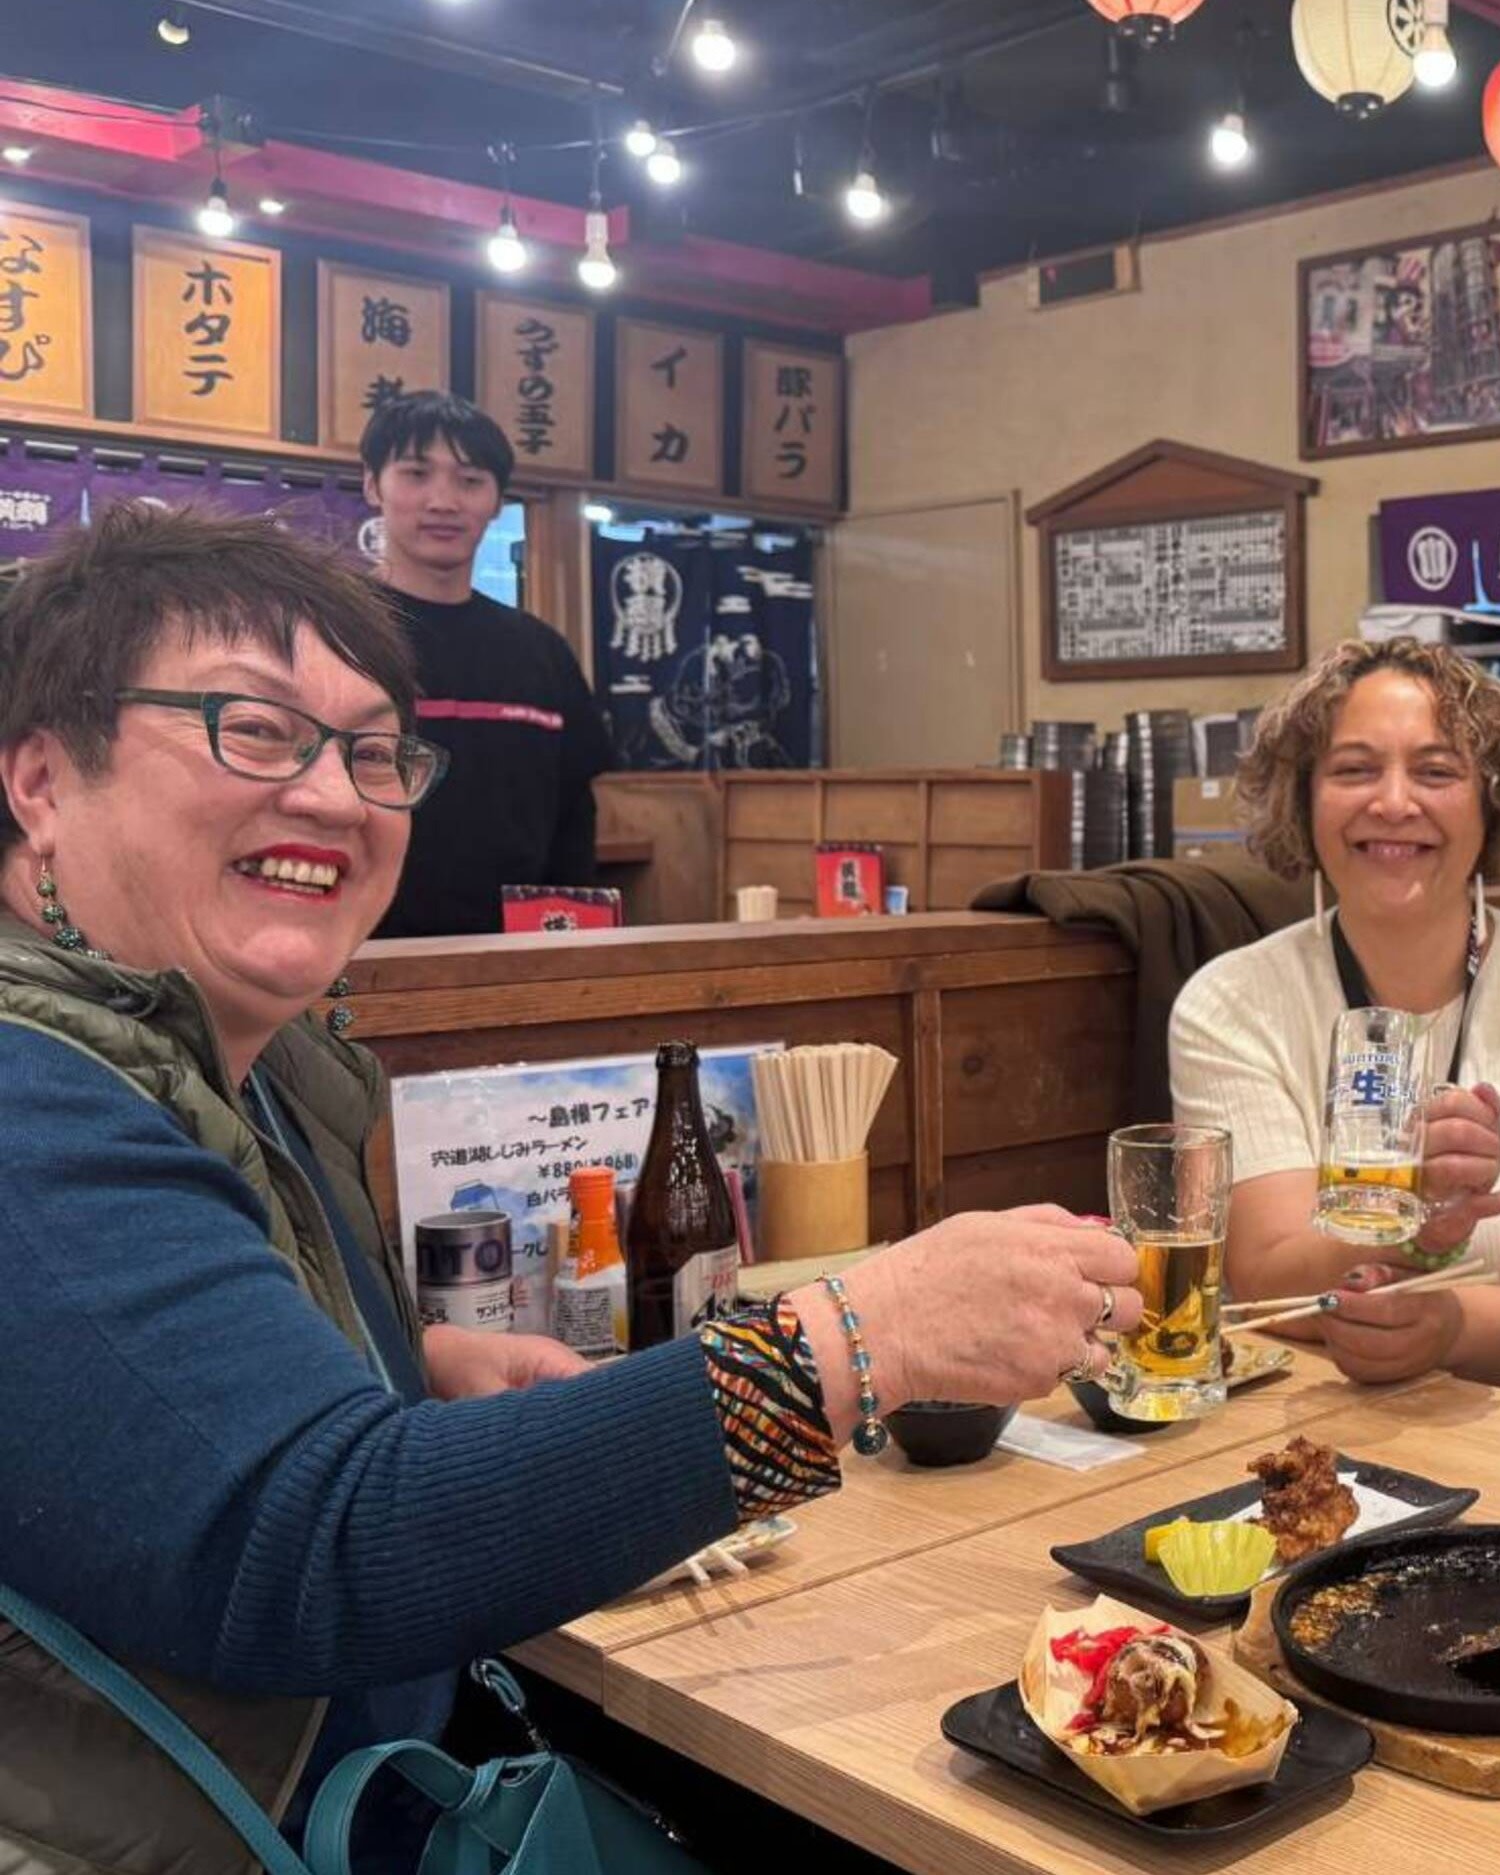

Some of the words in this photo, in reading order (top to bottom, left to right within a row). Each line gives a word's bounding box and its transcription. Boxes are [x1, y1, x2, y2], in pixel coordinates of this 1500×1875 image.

[183, 260, 233, 396] ホタテ
[650, 346, 688, 463] イカ
[774, 366, 816, 479] 豚バラ
[528, 1098, 657, 1127] ～島根フェア
[1352, 1068, 1385, 1106] 生
